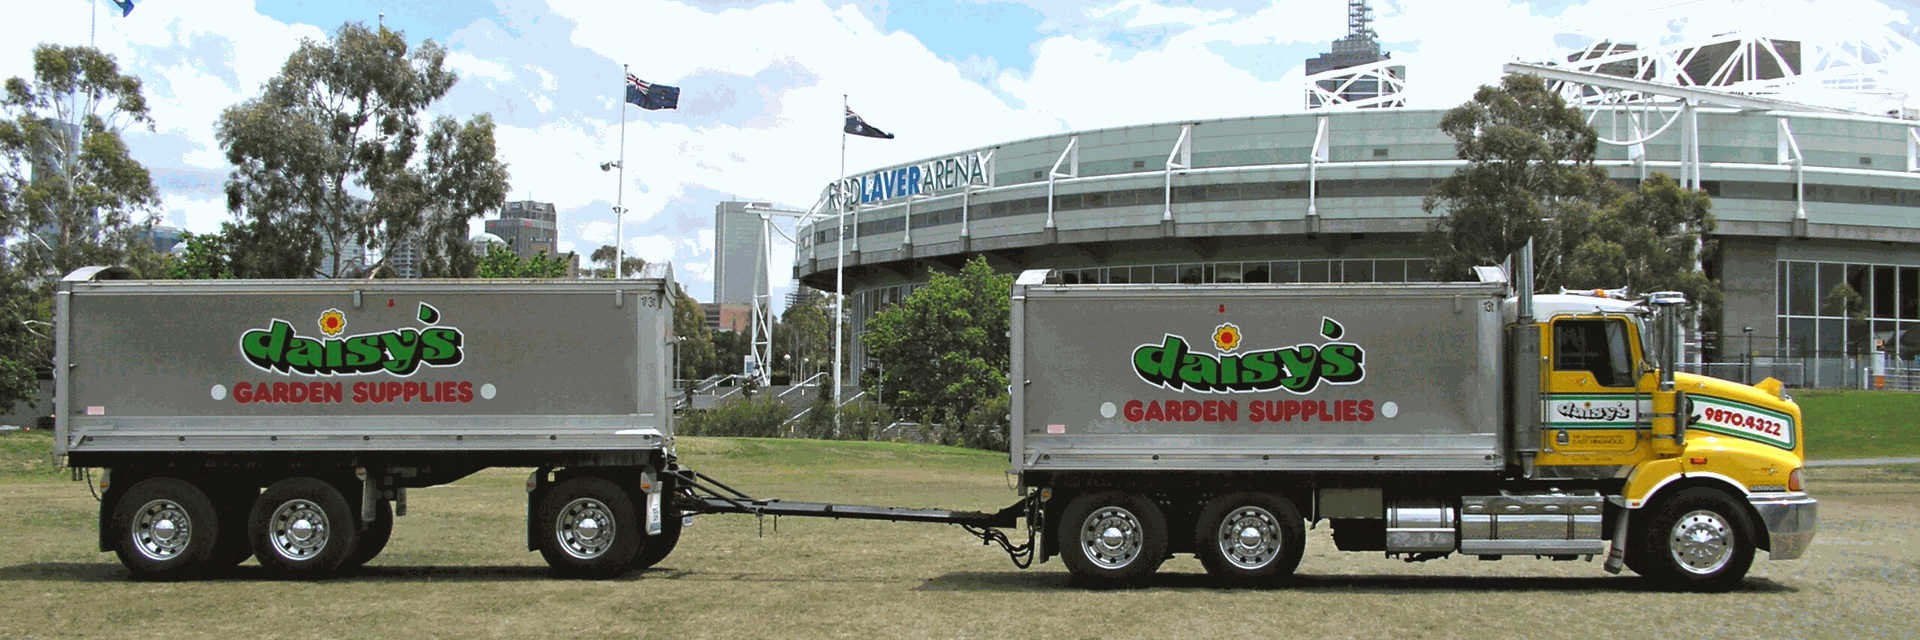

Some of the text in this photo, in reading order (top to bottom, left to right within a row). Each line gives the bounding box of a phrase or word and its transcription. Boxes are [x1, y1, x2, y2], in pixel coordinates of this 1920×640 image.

[828, 154, 985, 210] ROD LAVER ARENA
[240, 301, 464, 377] daisy's
[1131, 315, 1365, 395] daisy's
[233, 381, 474, 404] GARDEN SUPPLIES
[1123, 399, 1375, 422] GARDEN SUPPLIES
[1557, 401, 1630, 421] daisy's
[1705, 407, 1781, 436] 9870.4322
